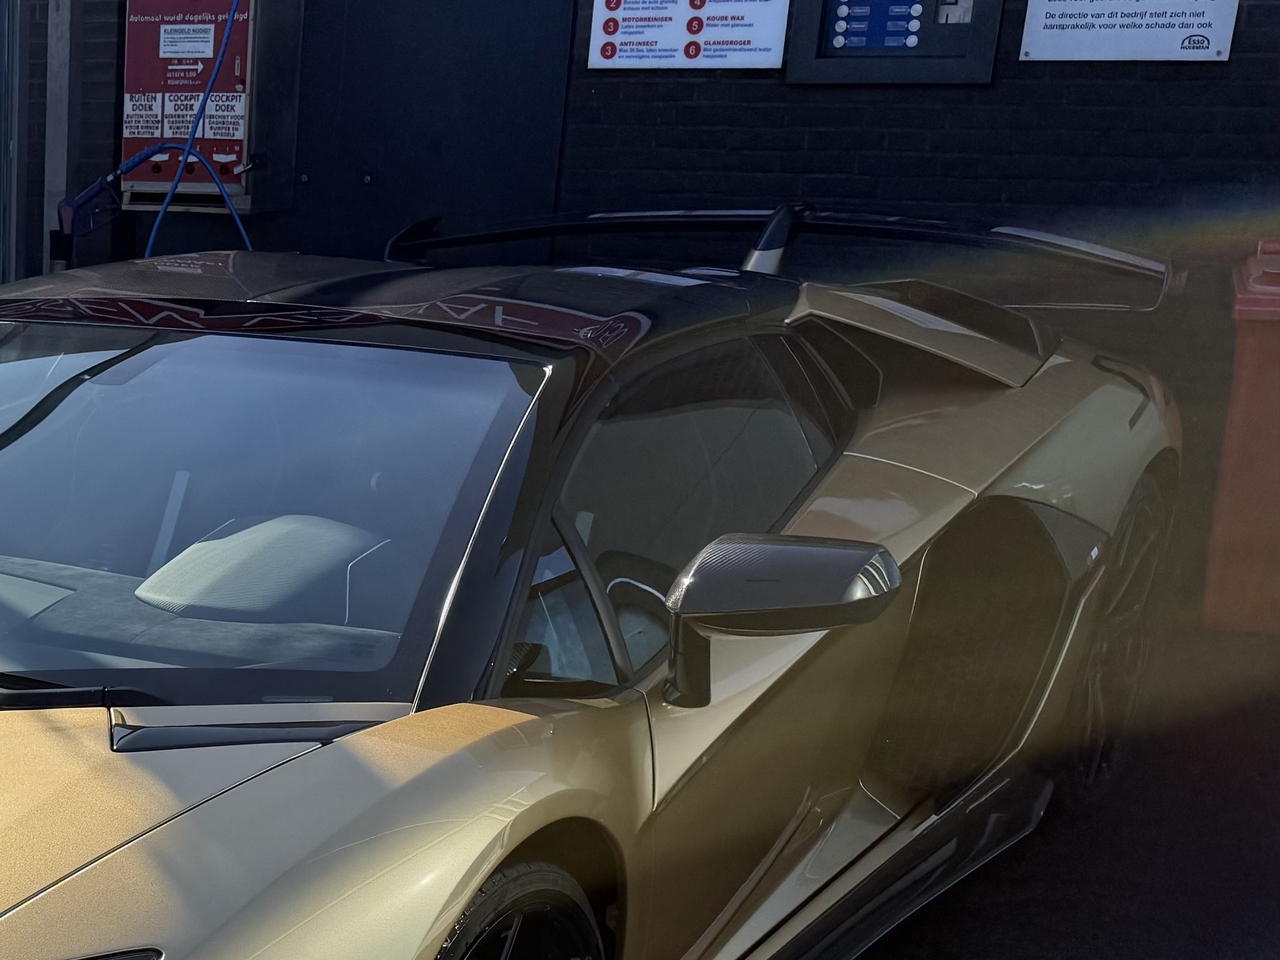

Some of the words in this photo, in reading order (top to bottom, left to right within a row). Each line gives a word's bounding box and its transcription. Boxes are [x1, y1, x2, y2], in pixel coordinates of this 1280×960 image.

[129, 14, 161, 22] Automaat
[1045, 11, 1056, 19] De
[1120, 11, 1147, 20] bedrijf
[1145, 21, 1176, 29] schade
[1178, 21, 1194, 29] dan
[1196, 21, 1213, 29] ook
[129, 94, 157, 103] RUITEN
[168, 94, 200, 102] COCKPIT
[210, 94, 242, 103] COCKPIT
[132, 103, 154, 112] DOEK
[174, 103, 195, 112] DOEK
[215, 104, 236, 112] DOEK
